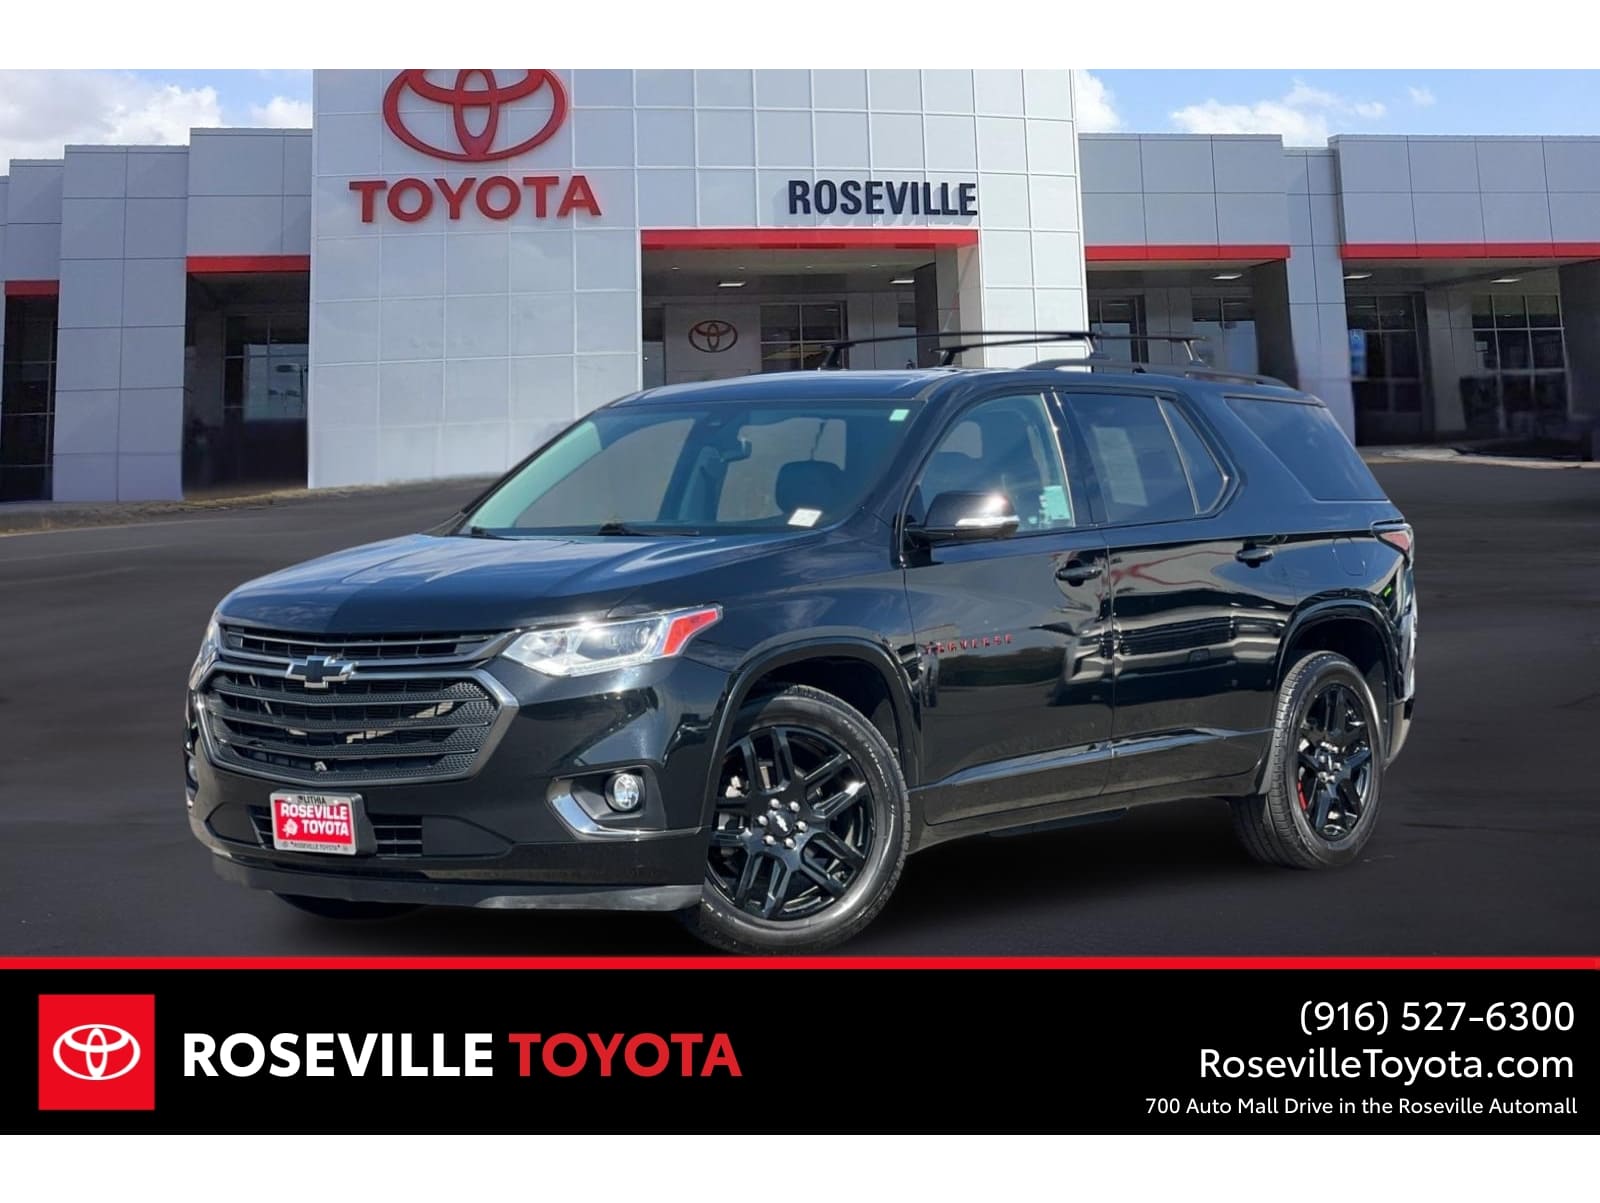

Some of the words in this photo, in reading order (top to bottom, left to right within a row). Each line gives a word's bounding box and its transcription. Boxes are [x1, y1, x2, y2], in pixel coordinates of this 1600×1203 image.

[349, 175, 602, 223] TOYOTA
[789, 180, 978, 216] ROSEVILLE
[281, 803, 348, 820] ROSEVILLE
[301, 819, 350, 837] TOYOTA
